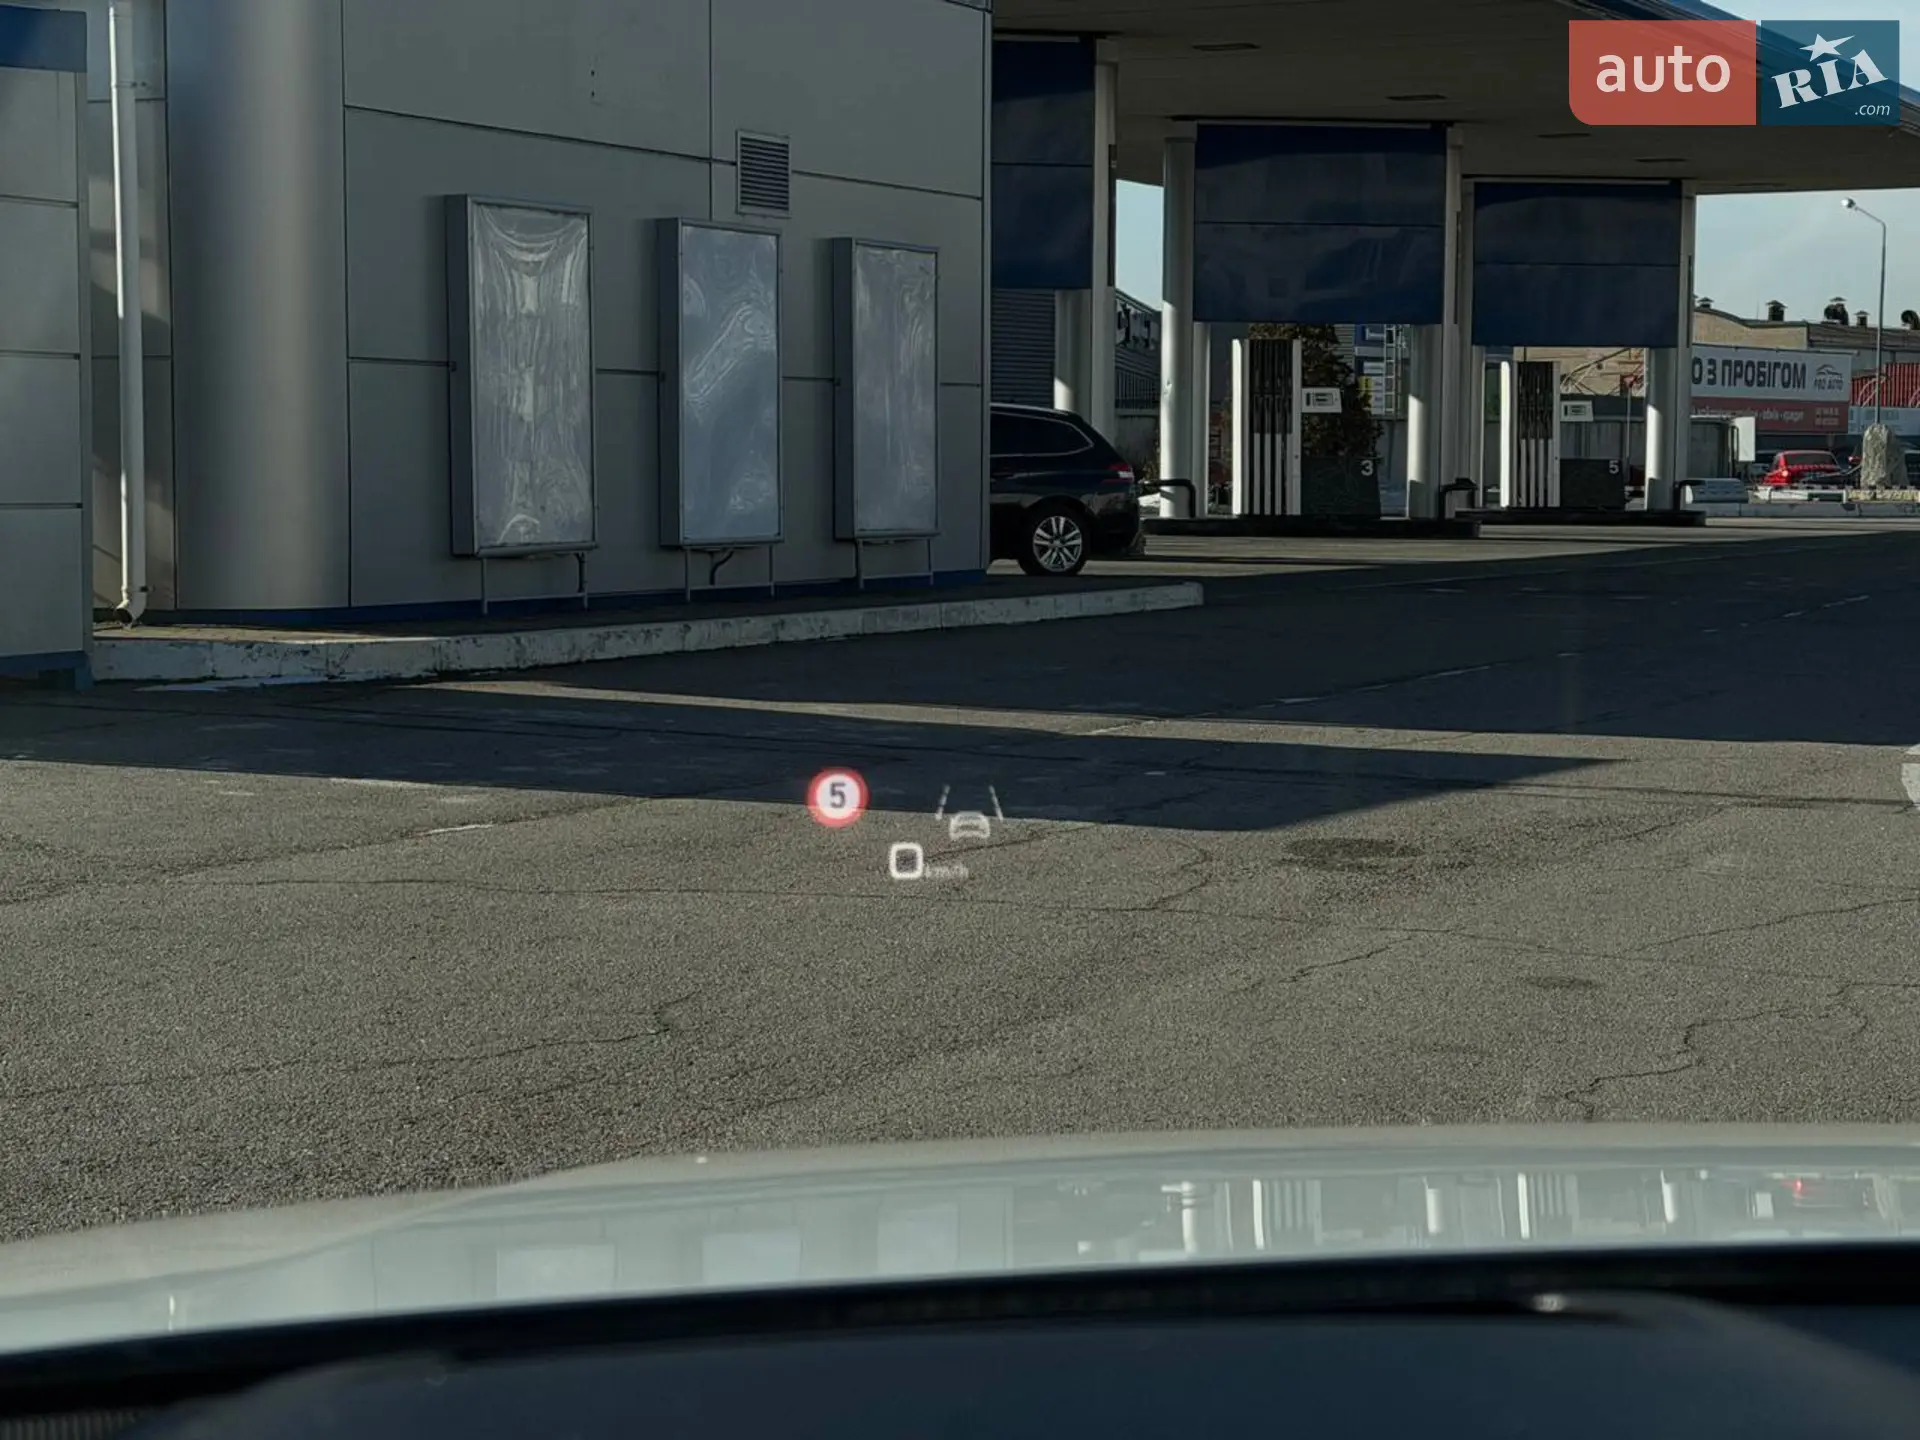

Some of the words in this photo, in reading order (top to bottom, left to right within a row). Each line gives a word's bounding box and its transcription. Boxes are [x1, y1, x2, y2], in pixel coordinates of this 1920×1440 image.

[1721, 359, 1807, 389] ПРОБІГОМ
[1361, 459, 1373, 476] 3
[1609, 460, 1619, 474] 5
[830, 782, 846, 808] 5
[889, 842, 923, 879] 0
